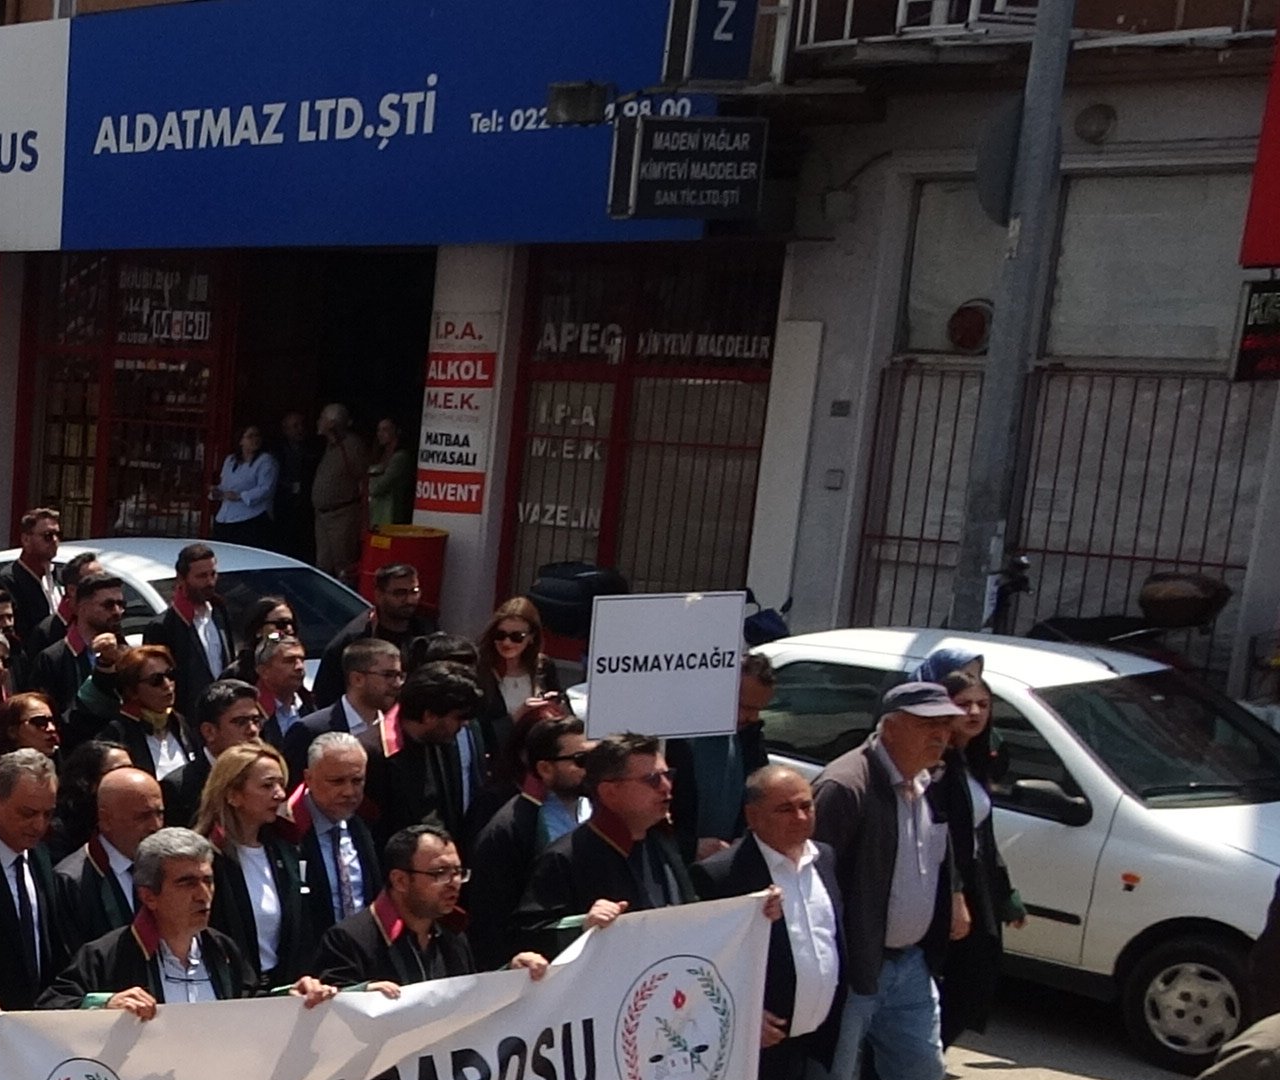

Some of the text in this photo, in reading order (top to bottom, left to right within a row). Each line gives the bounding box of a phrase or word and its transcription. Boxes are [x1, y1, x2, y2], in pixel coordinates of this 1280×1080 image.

[93, 102, 287, 155] ALDATMAZ
[470, 113, 503, 134] Tel:
[428, 359, 489, 381] ALKOL
[425, 431, 471, 448] MATBAA
[416, 480, 481, 503] SOLVENT
[595, 645, 736, 676] SUSMAYACAĞIZ
